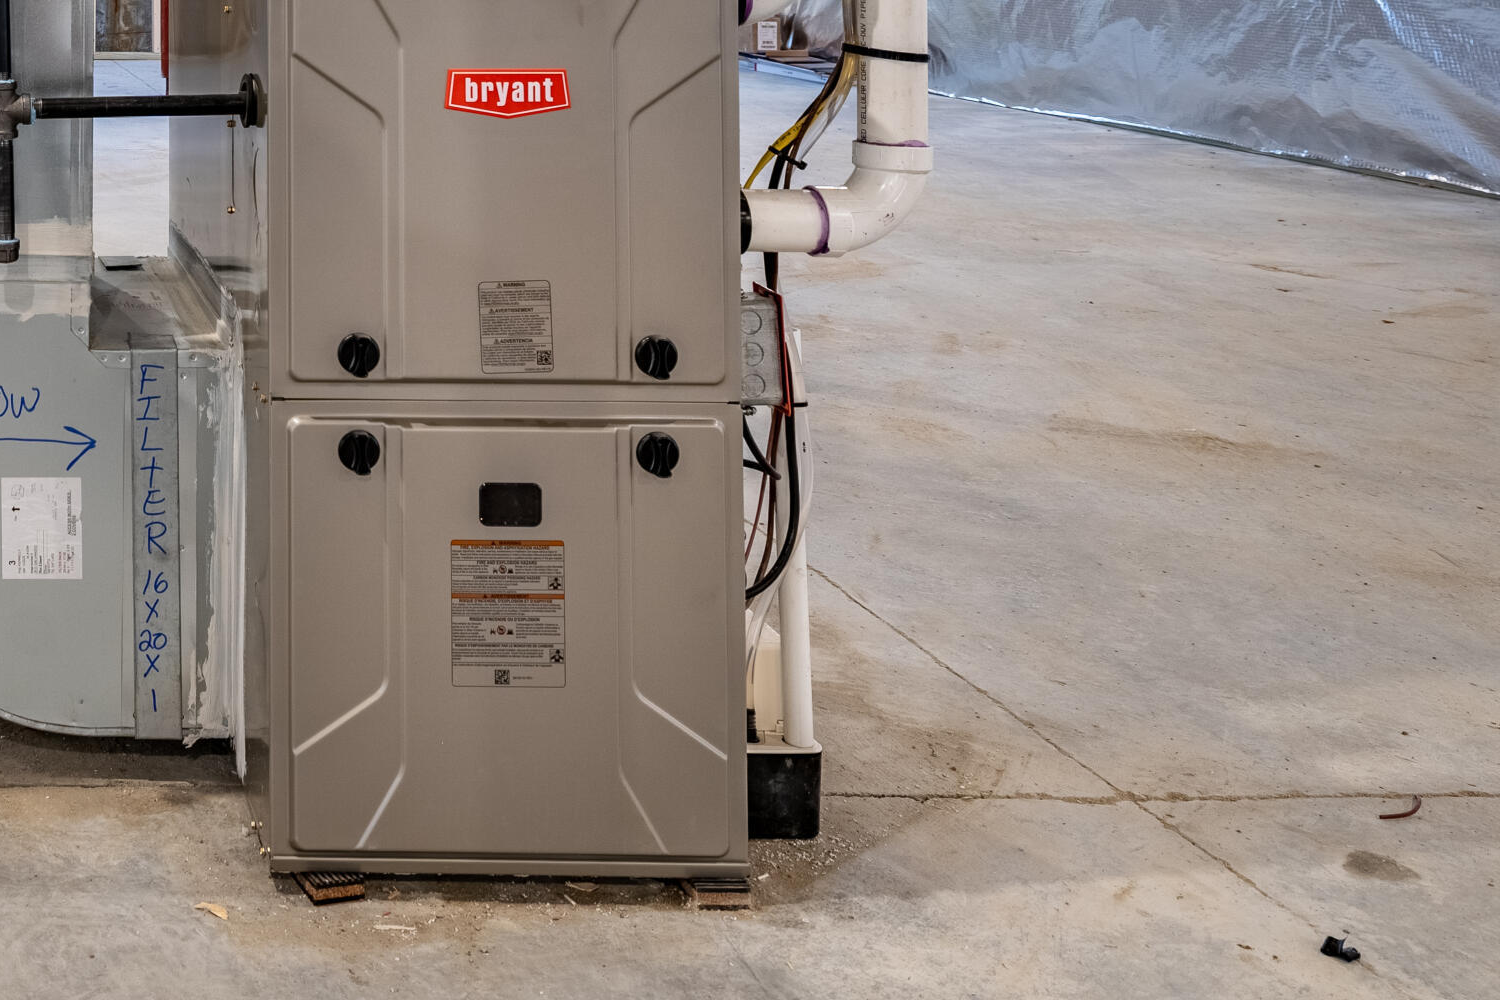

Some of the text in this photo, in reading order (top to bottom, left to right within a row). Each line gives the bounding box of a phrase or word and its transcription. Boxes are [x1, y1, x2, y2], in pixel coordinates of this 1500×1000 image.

[465, 78, 553, 107] bryant
[142, 570, 168, 595] 16
[139, 629, 167, 652] 20
